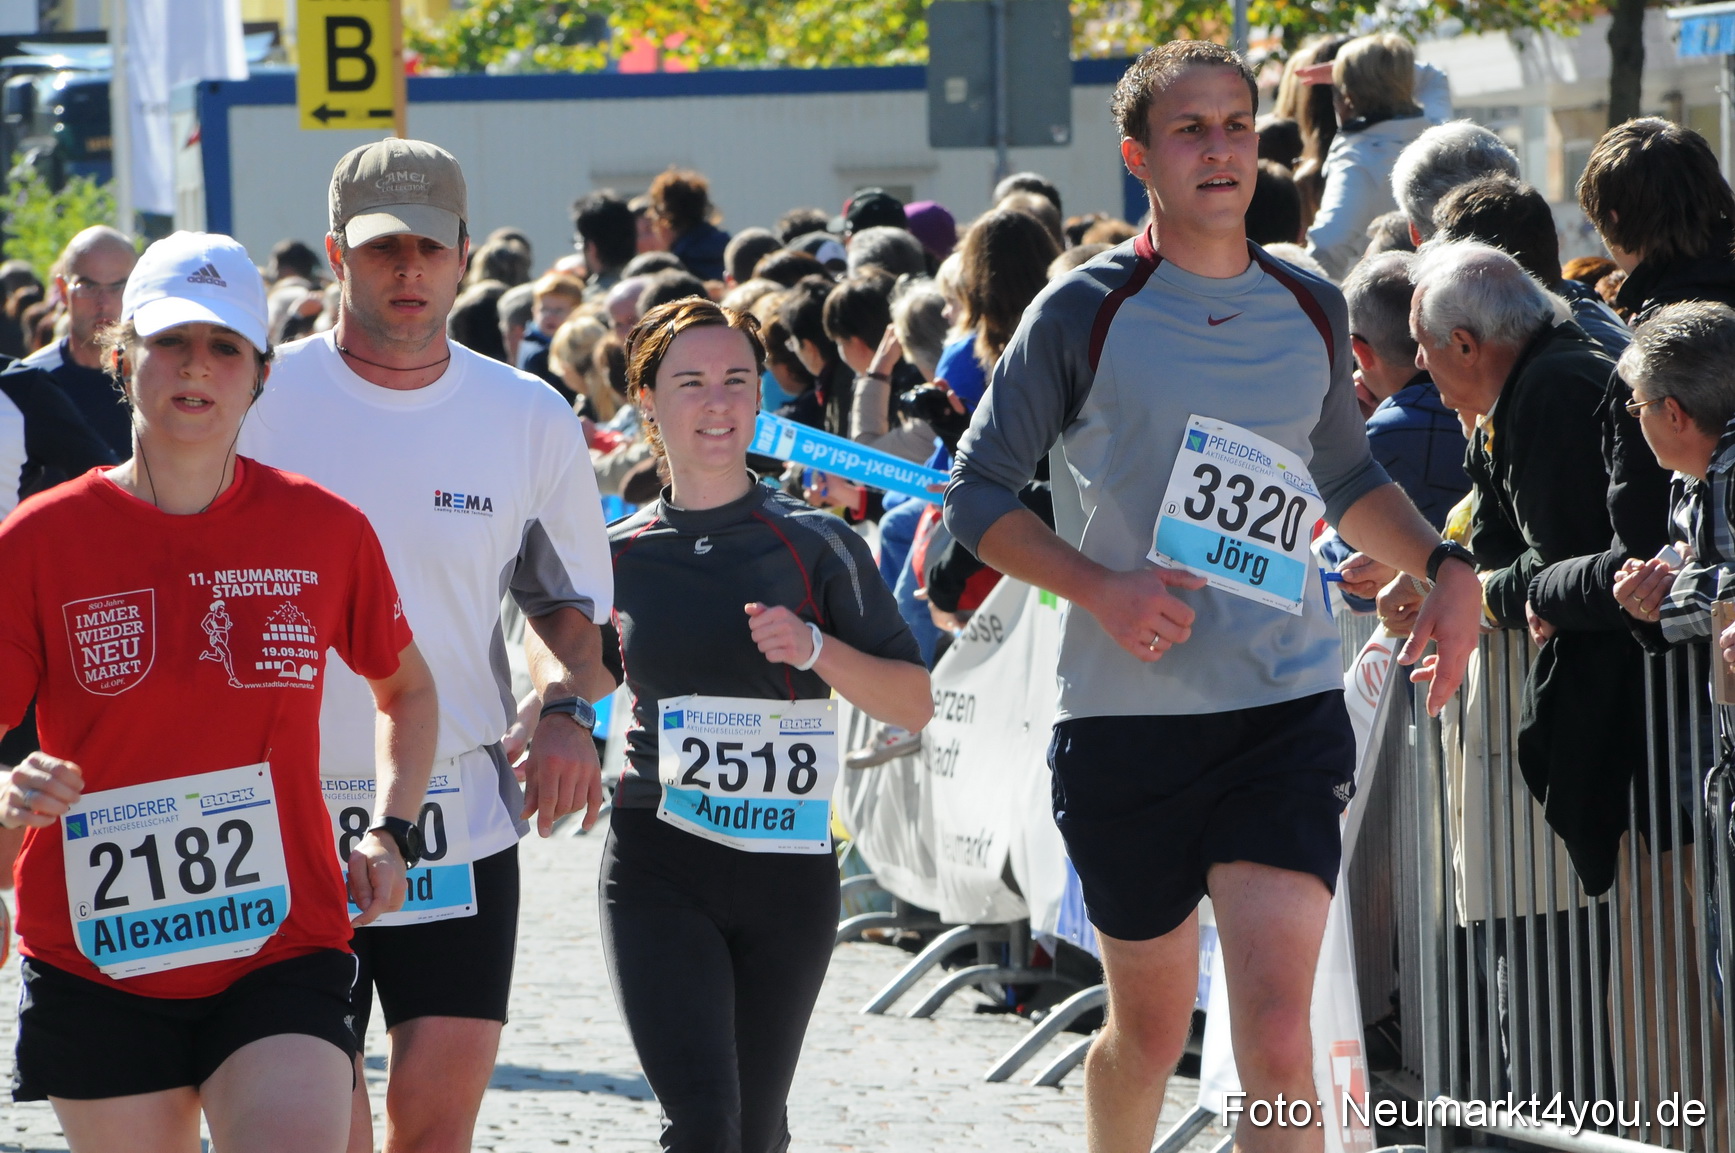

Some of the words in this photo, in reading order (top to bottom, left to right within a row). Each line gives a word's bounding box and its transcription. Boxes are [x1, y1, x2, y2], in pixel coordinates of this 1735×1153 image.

[325, 16, 377, 92] B
[375, 171, 430, 189] CAMEL
[187, 276, 227, 287] adidas
[802, 439, 942, 488] w.maxi-dsl.de
[1168, 504, 1176, 514] D
[1183, 463, 1307, 552] 3320
[1206, 536, 1269, 586] Jörg
[188, 572, 211, 586] 11.
[214, 568, 319, 585] NEUMARKTER
[212, 582, 301, 598] STADTLAUF
[88, 601, 103, 610] 850
[104, 599, 125, 608] Jahre
[75, 605, 140, 629] IMMER
[75, 620, 144, 645] WIEDER
[81, 637, 140, 667] NEU
[262, 647, 319, 660] 19.09.2010
[84, 659, 141, 683] MARKT
[1361, 660, 1389, 697] KI
[933, 688, 976, 723] erzen
[686, 710, 762, 727] PFLEIDERER
[686, 725, 761, 735] AKTIENGESELLSCHAFT
[779, 718, 822, 729] BOCK
[681, 736, 818, 795] 2518
[320, 779, 376, 791] LEIDERE
[200, 787, 255, 808] BOCK
[90, 797, 178, 826] PFLEIDERER
[695, 794, 796, 831] Andrea
[92, 814, 180, 837] AKTIENGESELLSCHAFT
[339, 802, 448, 863] 80
[89, 818, 261, 911] 2182
[79, 905, 87, 917] C
[94, 896, 275, 956] Alexandra
